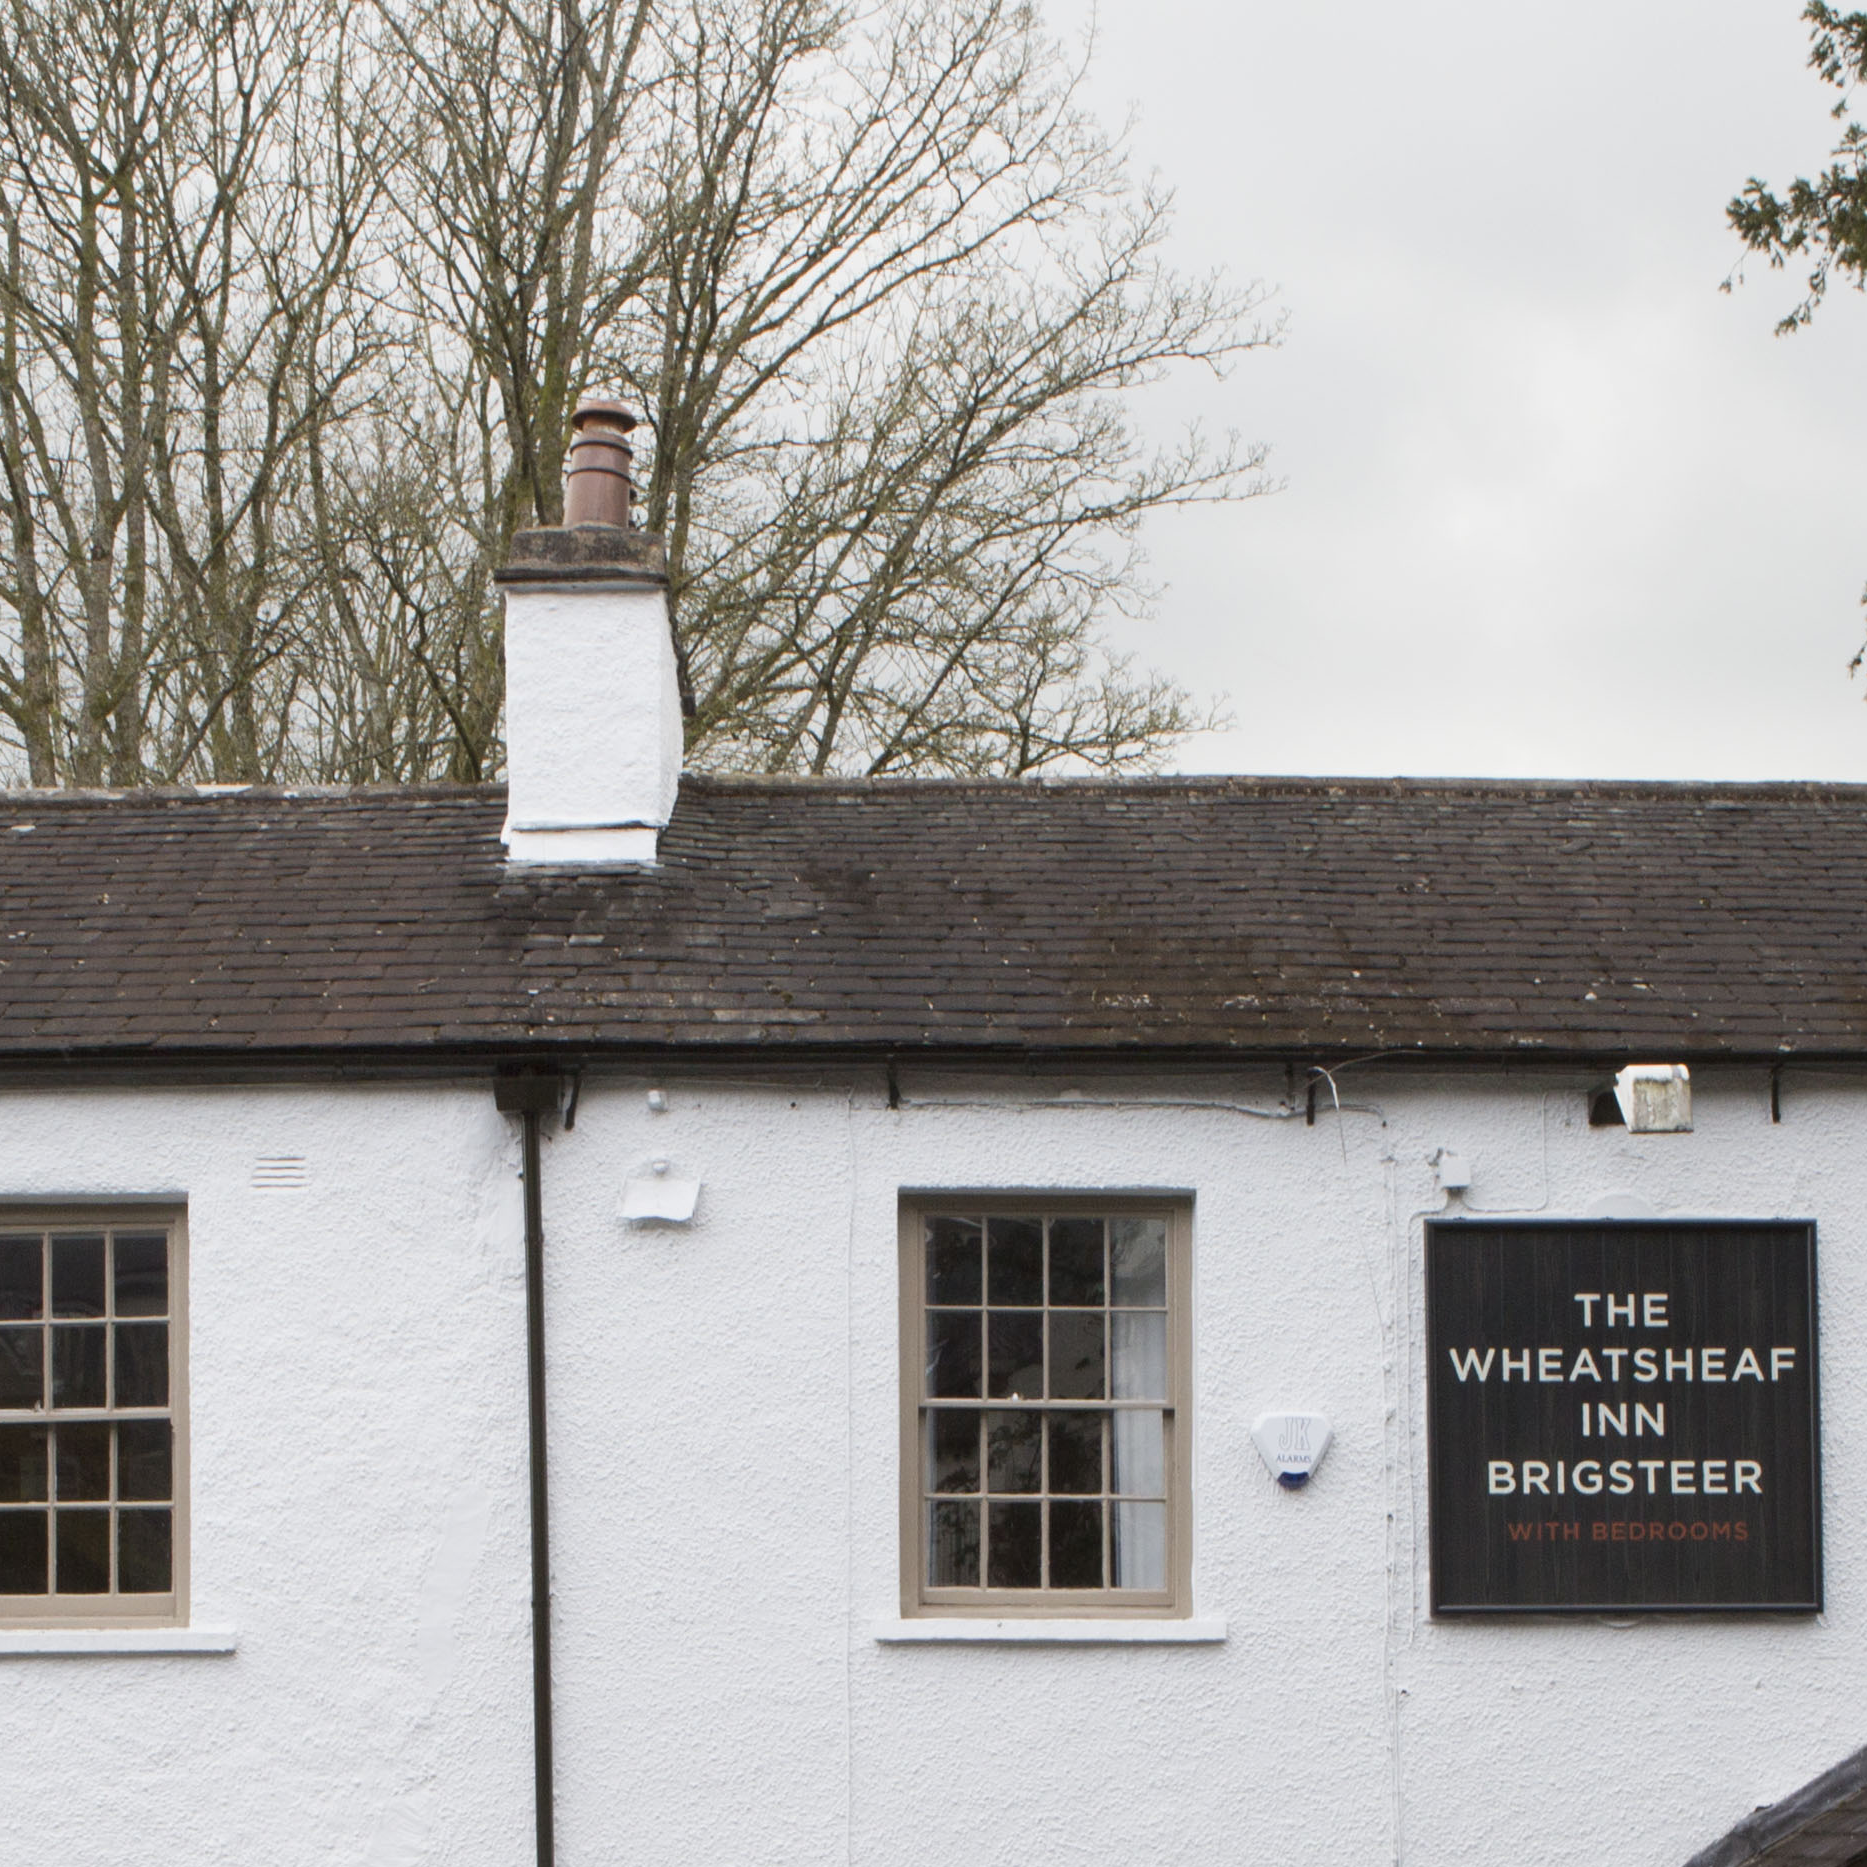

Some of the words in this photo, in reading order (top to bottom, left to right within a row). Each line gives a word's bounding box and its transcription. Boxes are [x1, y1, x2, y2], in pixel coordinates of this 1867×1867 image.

[1574, 1293, 1670, 1328] THE
[1449, 1347, 1796, 1383] WHEATSHEAF
[1278, 1416, 1311, 1450] JK
[1581, 1402, 1665, 1437] INN
[1276, 1454, 1312, 1463] ALARMS
[1487, 1459, 1763, 1495] BRIGSTEER
[1507, 1521, 1581, 1542] WITH
[1591, 1520, 1750, 1542] BEDROOMS
